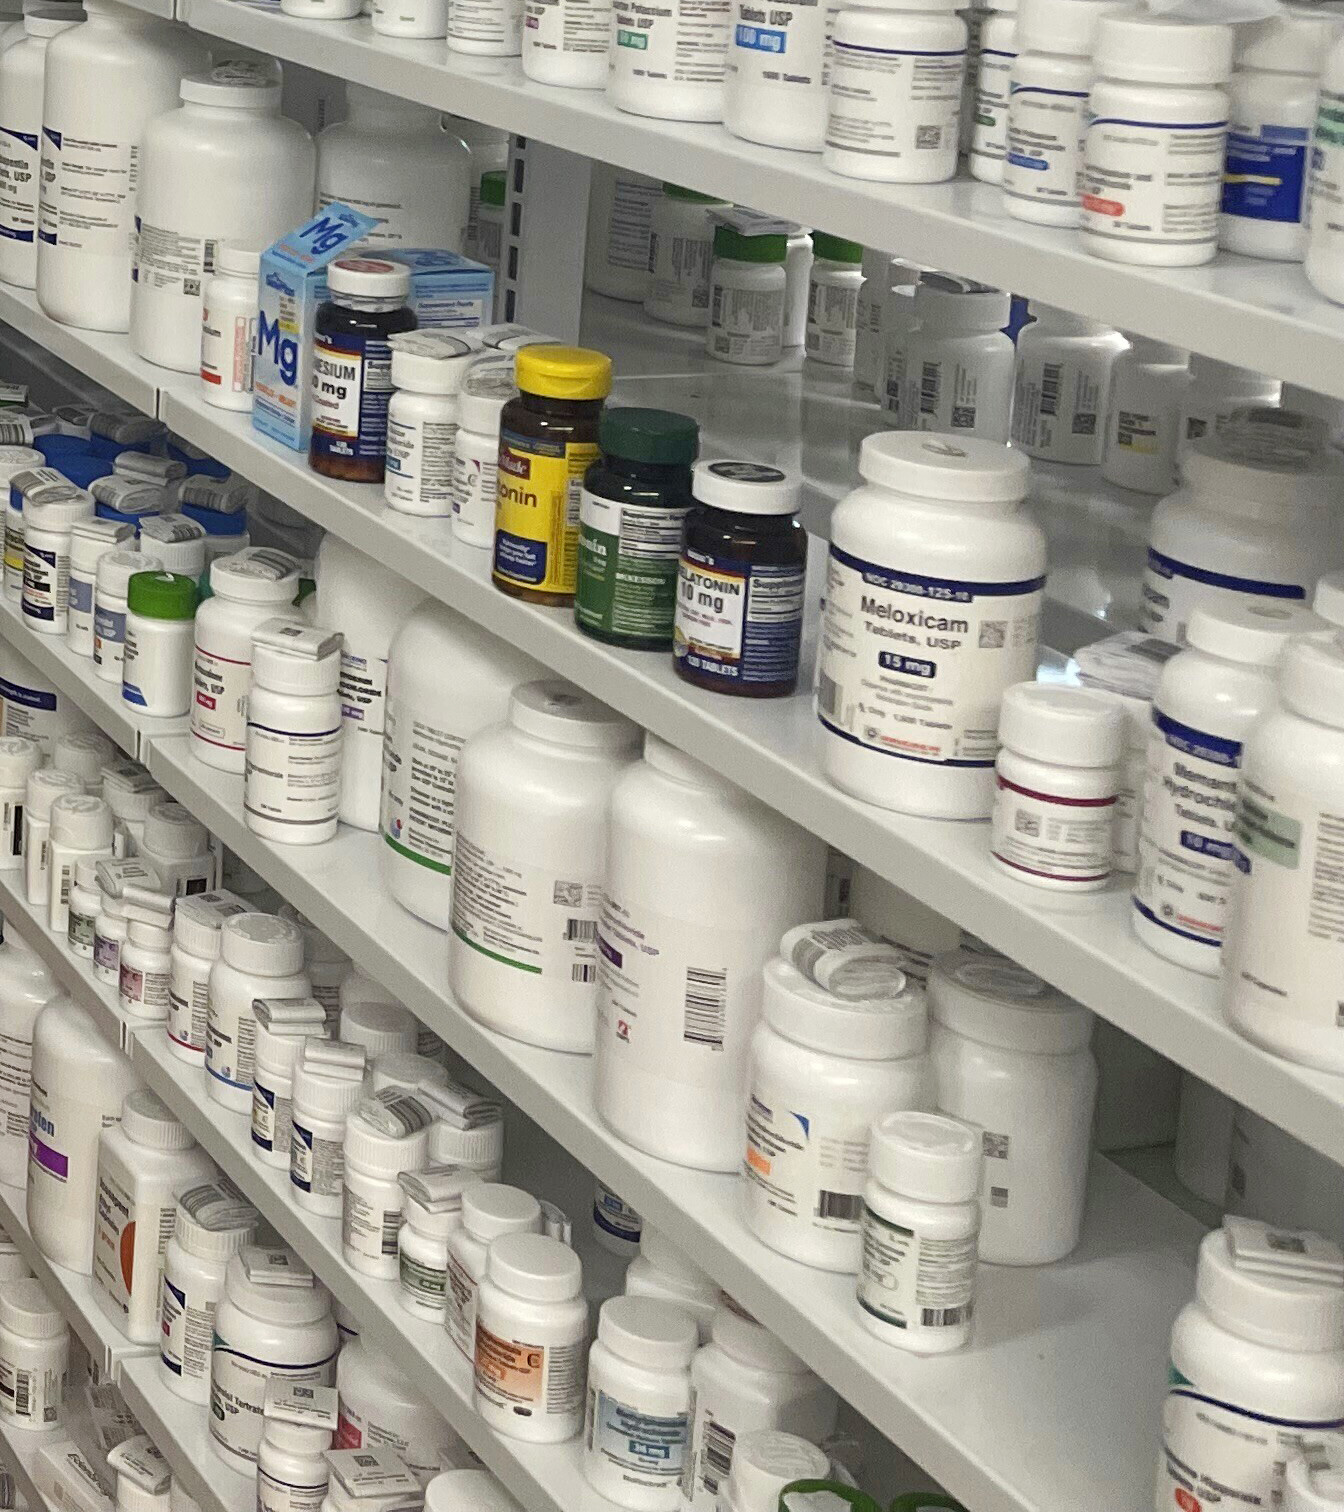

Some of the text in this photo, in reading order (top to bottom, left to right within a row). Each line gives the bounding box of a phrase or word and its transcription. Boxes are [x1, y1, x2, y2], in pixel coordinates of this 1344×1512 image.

[300, 217, 349, 255] Mg
[258, 310, 298, 387] Mg
[317, 355, 356, 381] ESIUM
[321, 382, 347, 399] mg
[698, 594, 723, 613] mg
[861, 596, 968, 633] Meloxicam
[926, 637, 962, 649] USP
[884, 654, 930, 675] 15 mg
